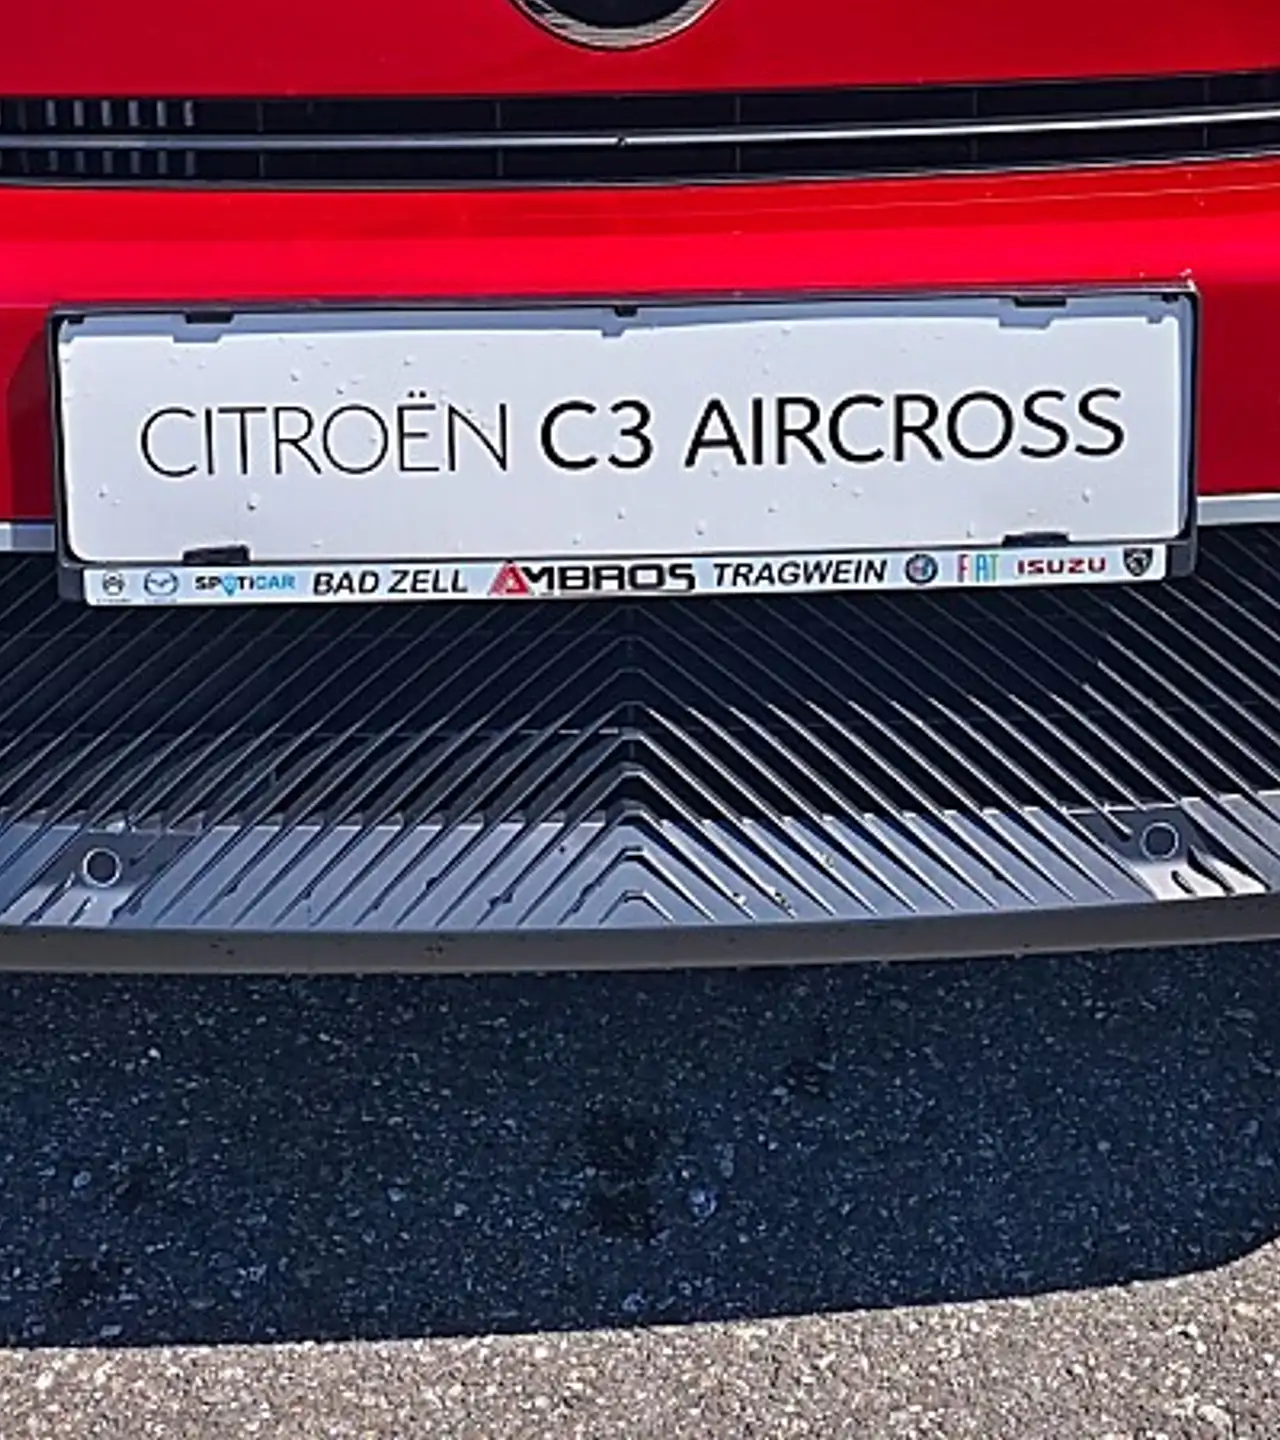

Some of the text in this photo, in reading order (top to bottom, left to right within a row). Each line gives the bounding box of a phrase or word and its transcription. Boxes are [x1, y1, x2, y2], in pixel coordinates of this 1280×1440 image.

[140, 388, 1125, 477] CITROËN C3 AIRCROSS
[487, 559, 696, 597] AMBROS
[713, 559, 888, 588] TRAGWEIN
[1017, 557, 1106, 575] ISUZU
[312, 569, 469, 595] BAD ZELL
